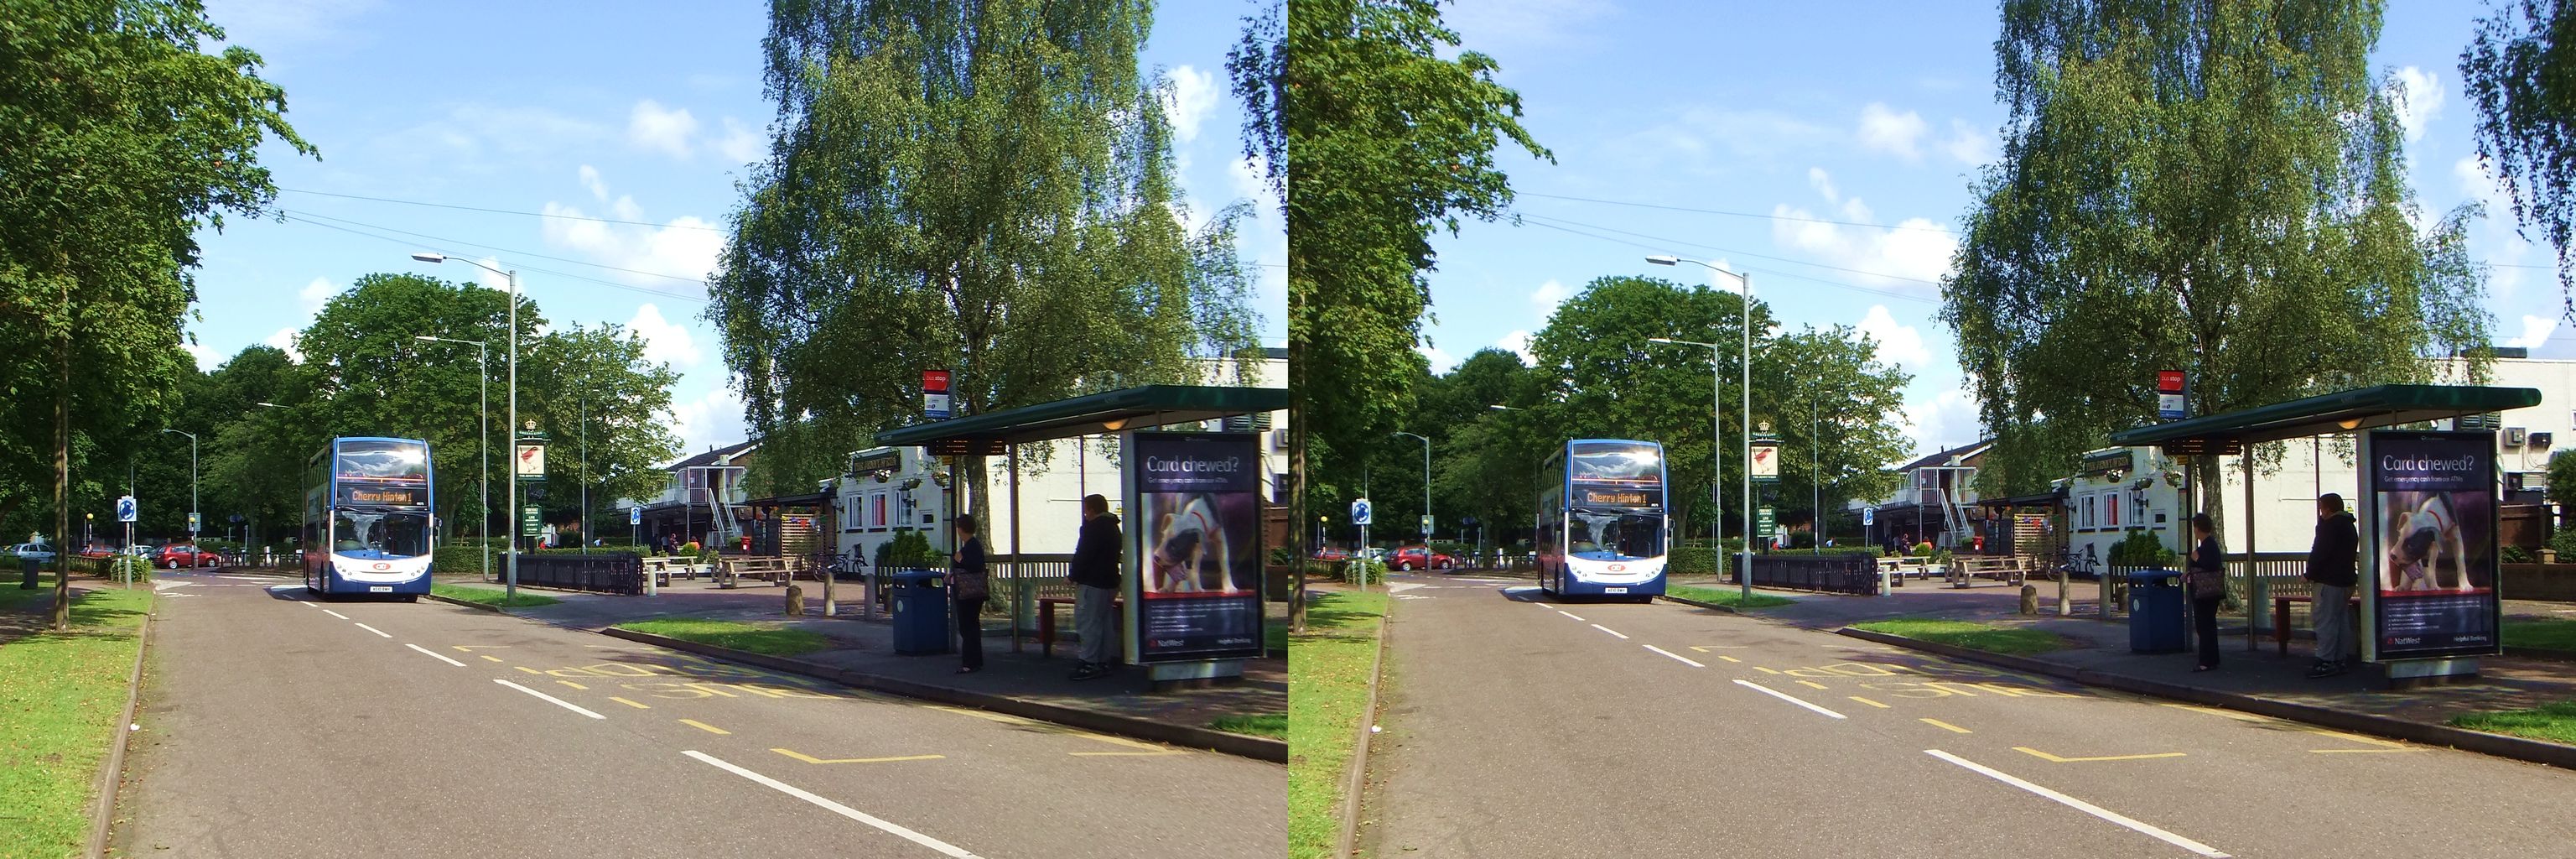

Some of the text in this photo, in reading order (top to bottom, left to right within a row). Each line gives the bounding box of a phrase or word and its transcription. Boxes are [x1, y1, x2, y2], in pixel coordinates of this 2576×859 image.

[1147, 456, 1239, 472] Card chewed?
[2383, 454, 2474, 471] Card chewed?
[353, 491, 412, 502] Cherry Hinton 1
[1587, 492, 1647, 503] Cherry Hinton 1
[621, 682, 841, 699] BUS
[1860, 681, 2082, 699] BUS
